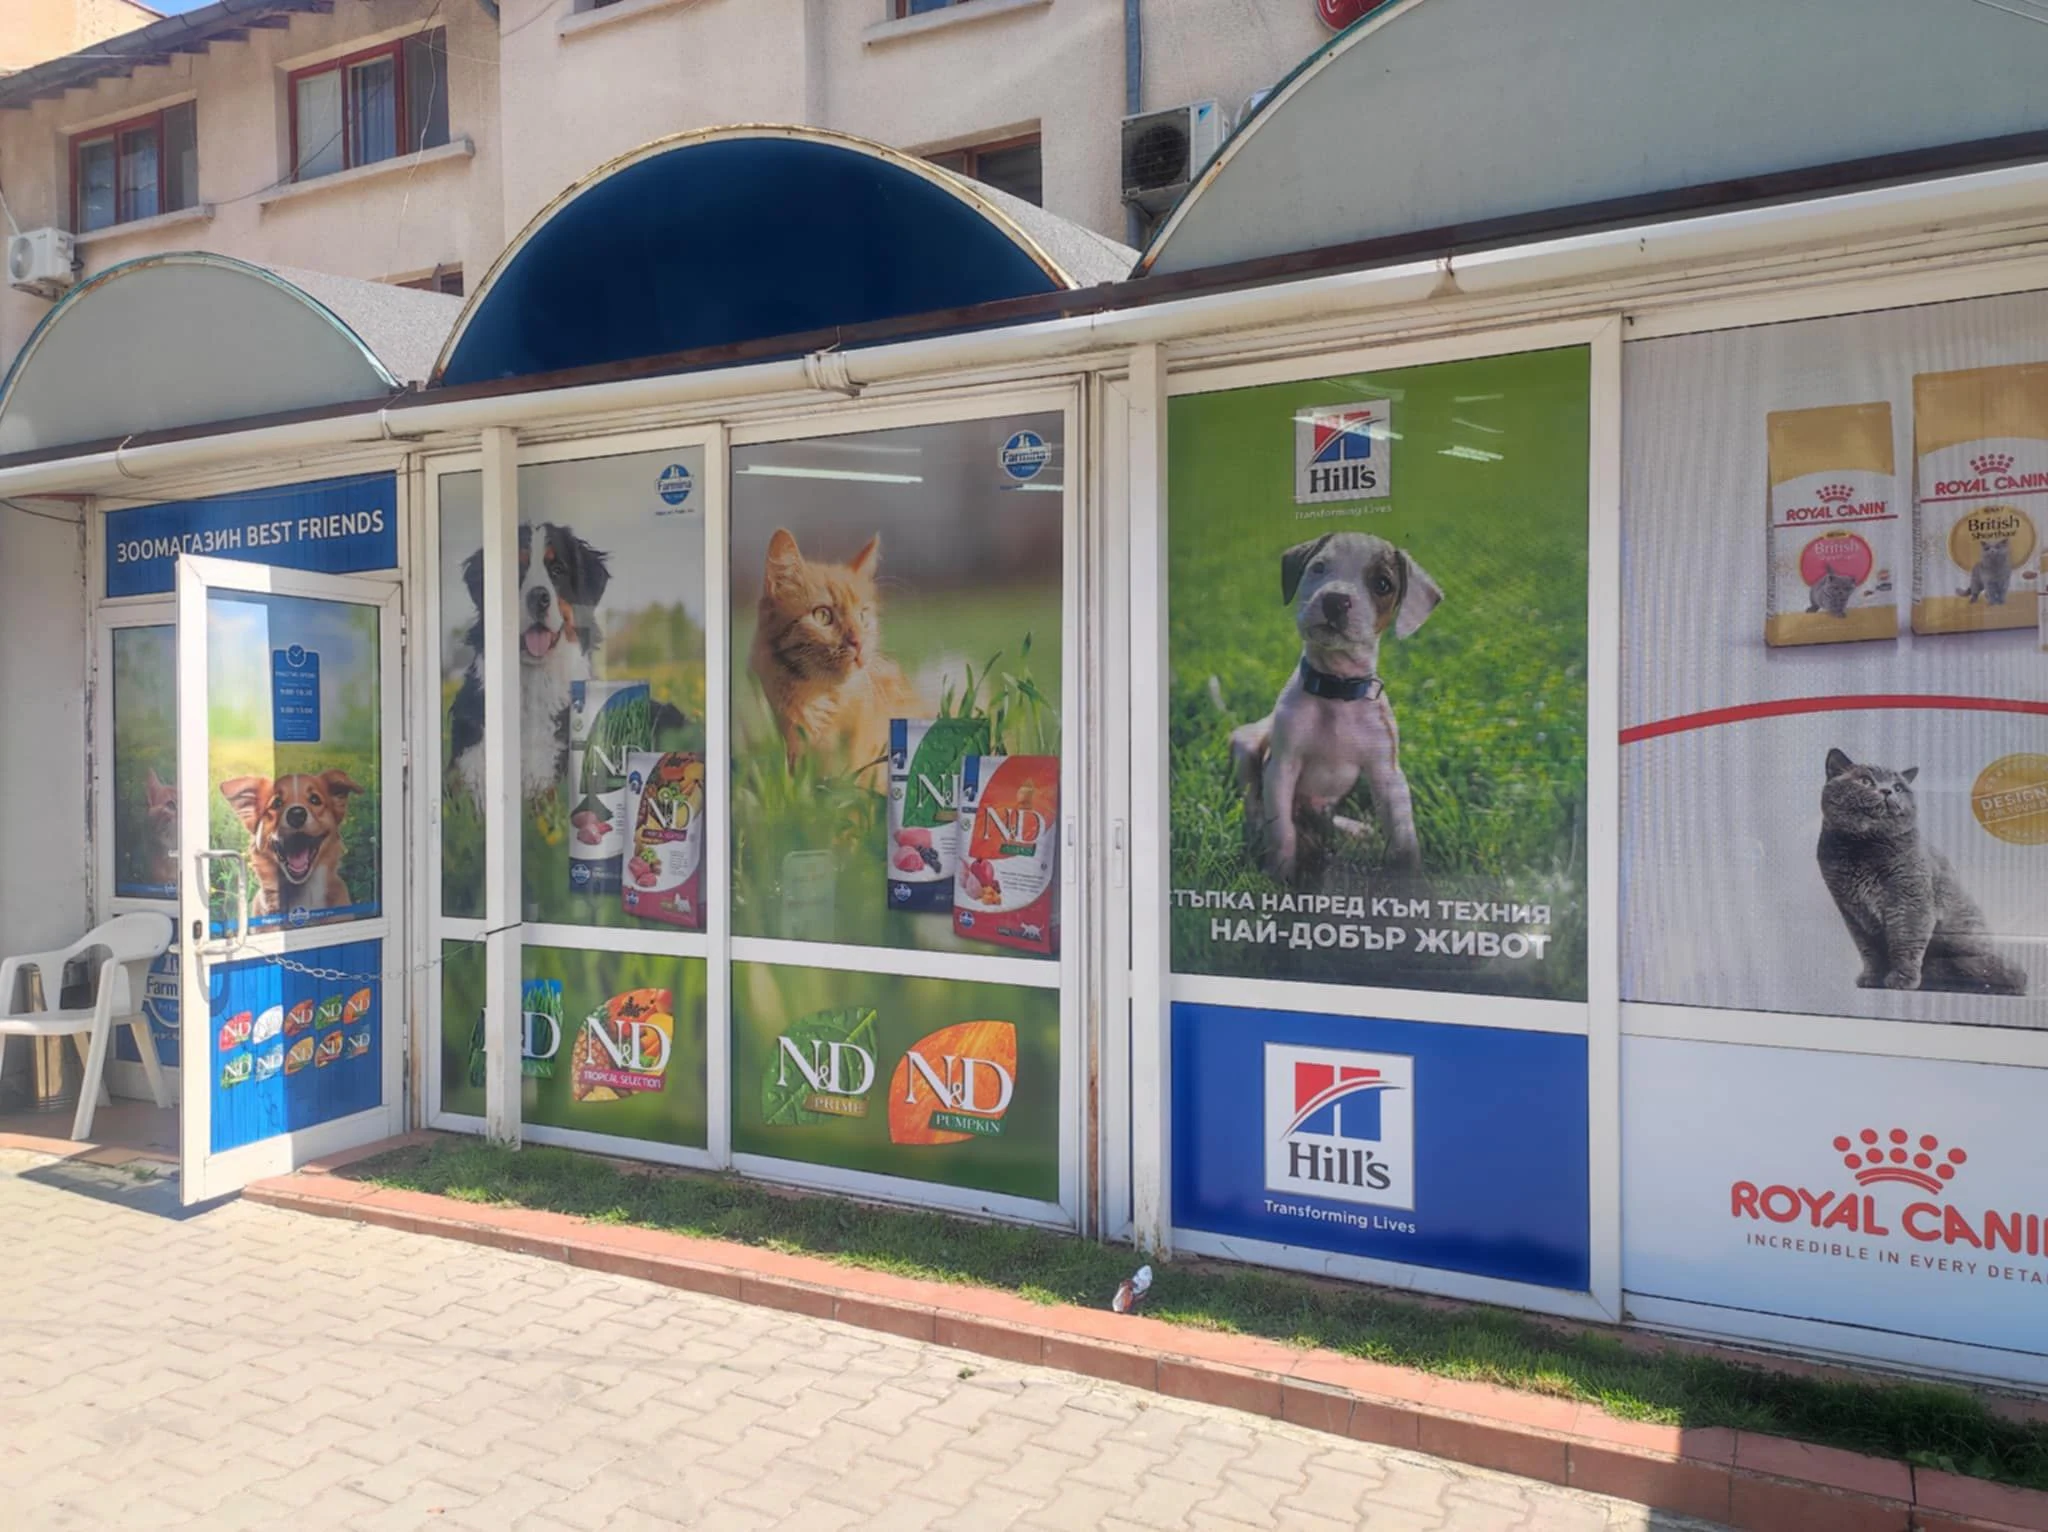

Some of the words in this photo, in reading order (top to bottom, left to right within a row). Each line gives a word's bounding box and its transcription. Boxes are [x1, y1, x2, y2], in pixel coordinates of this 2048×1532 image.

[1310, 464, 1376, 494] Hill's
[1935, 478, 1990, 495] ROYAL
[1786, 506, 1833, 521] ROYAL
[1837, 501, 1886, 517] CANIN
[1968, 515, 2020, 531] British
[117, 528, 241, 562] ЗООМАГАЗИН
[247, 521, 293, 547] BEST
[298, 510, 384, 541] FRIENDS
[1815, 540, 1859, 555] British
[984, 807, 1046, 844] N&D
[1170, 889, 1255, 911] ТЪПКА
[1261, 893, 1366, 919] НАПРЕД
[1371, 897, 1430, 919] КЪМ
[1437, 899, 1552, 924] ТЕХНИЯ
[1210, 913, 1407, 950] НАЙ-ДОБЪР
[1414, 927, 1552, 960] ЖИВОТ
[146, 976, 178, 996] Farm
[585, 1016, 672, 1071] N&D
[584, 1070, 617, 1084] TROPICAL
[620, 1075, 662, 1089] SELECTION
[776, 1036, 876, 1095] N&D
[905, 1051, 1015, 1114] N&D
[815, 1099, 864, 1113] PRIME
[935, 1113, 1001, 1133] PUMPKIN
[1288, 1141, 1391, 1190] Hill's
[1264, 1199, 1368, 1229] Transforming
[1373, 1215, 1416, 1234] Lives
[1731, 1181, 1889, 1236] ROYAL
[1747, 1233, 1869, 1260] INCREDIBLE
[1879, 1251, 1900, 1265] IN
[1910, 1254, 1977, 1275] EVERY
